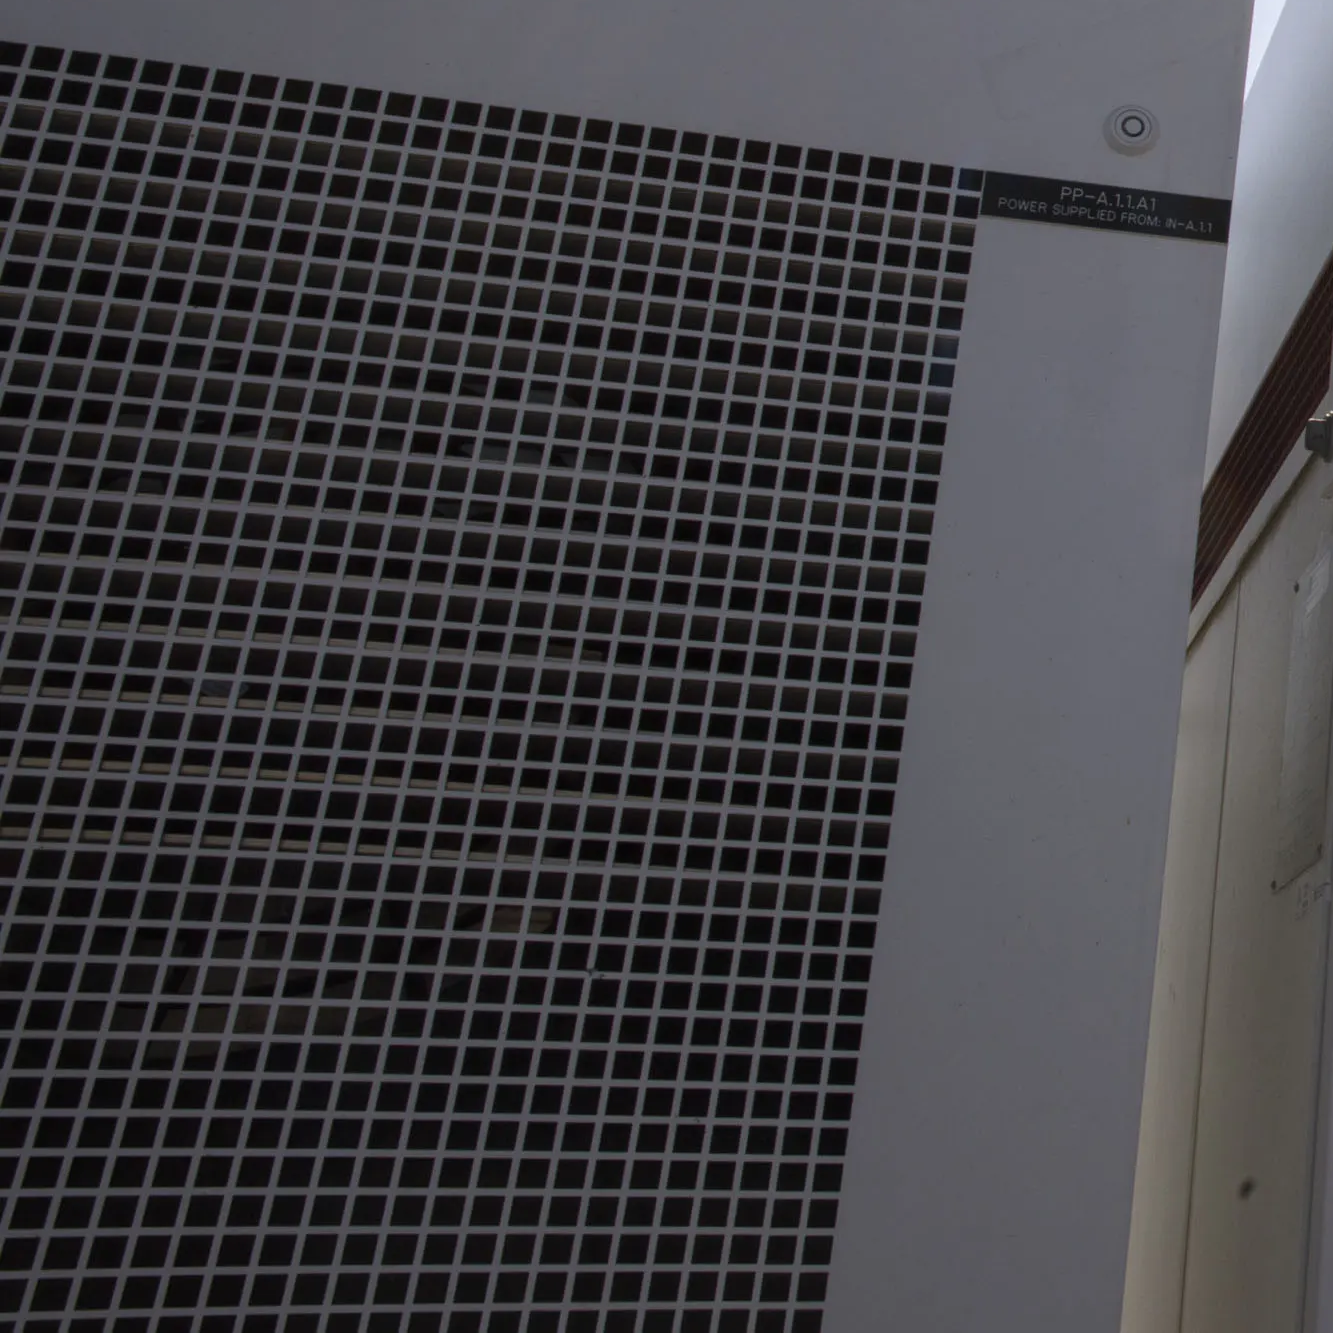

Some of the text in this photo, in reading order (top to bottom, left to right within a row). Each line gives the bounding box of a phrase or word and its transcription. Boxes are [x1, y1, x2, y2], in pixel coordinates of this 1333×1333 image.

[998, 197, 1048, 213] POWER
[1052, 202, 1117, 222] SUPPLIED
[1121, 211, 1161, 227] FROM:
